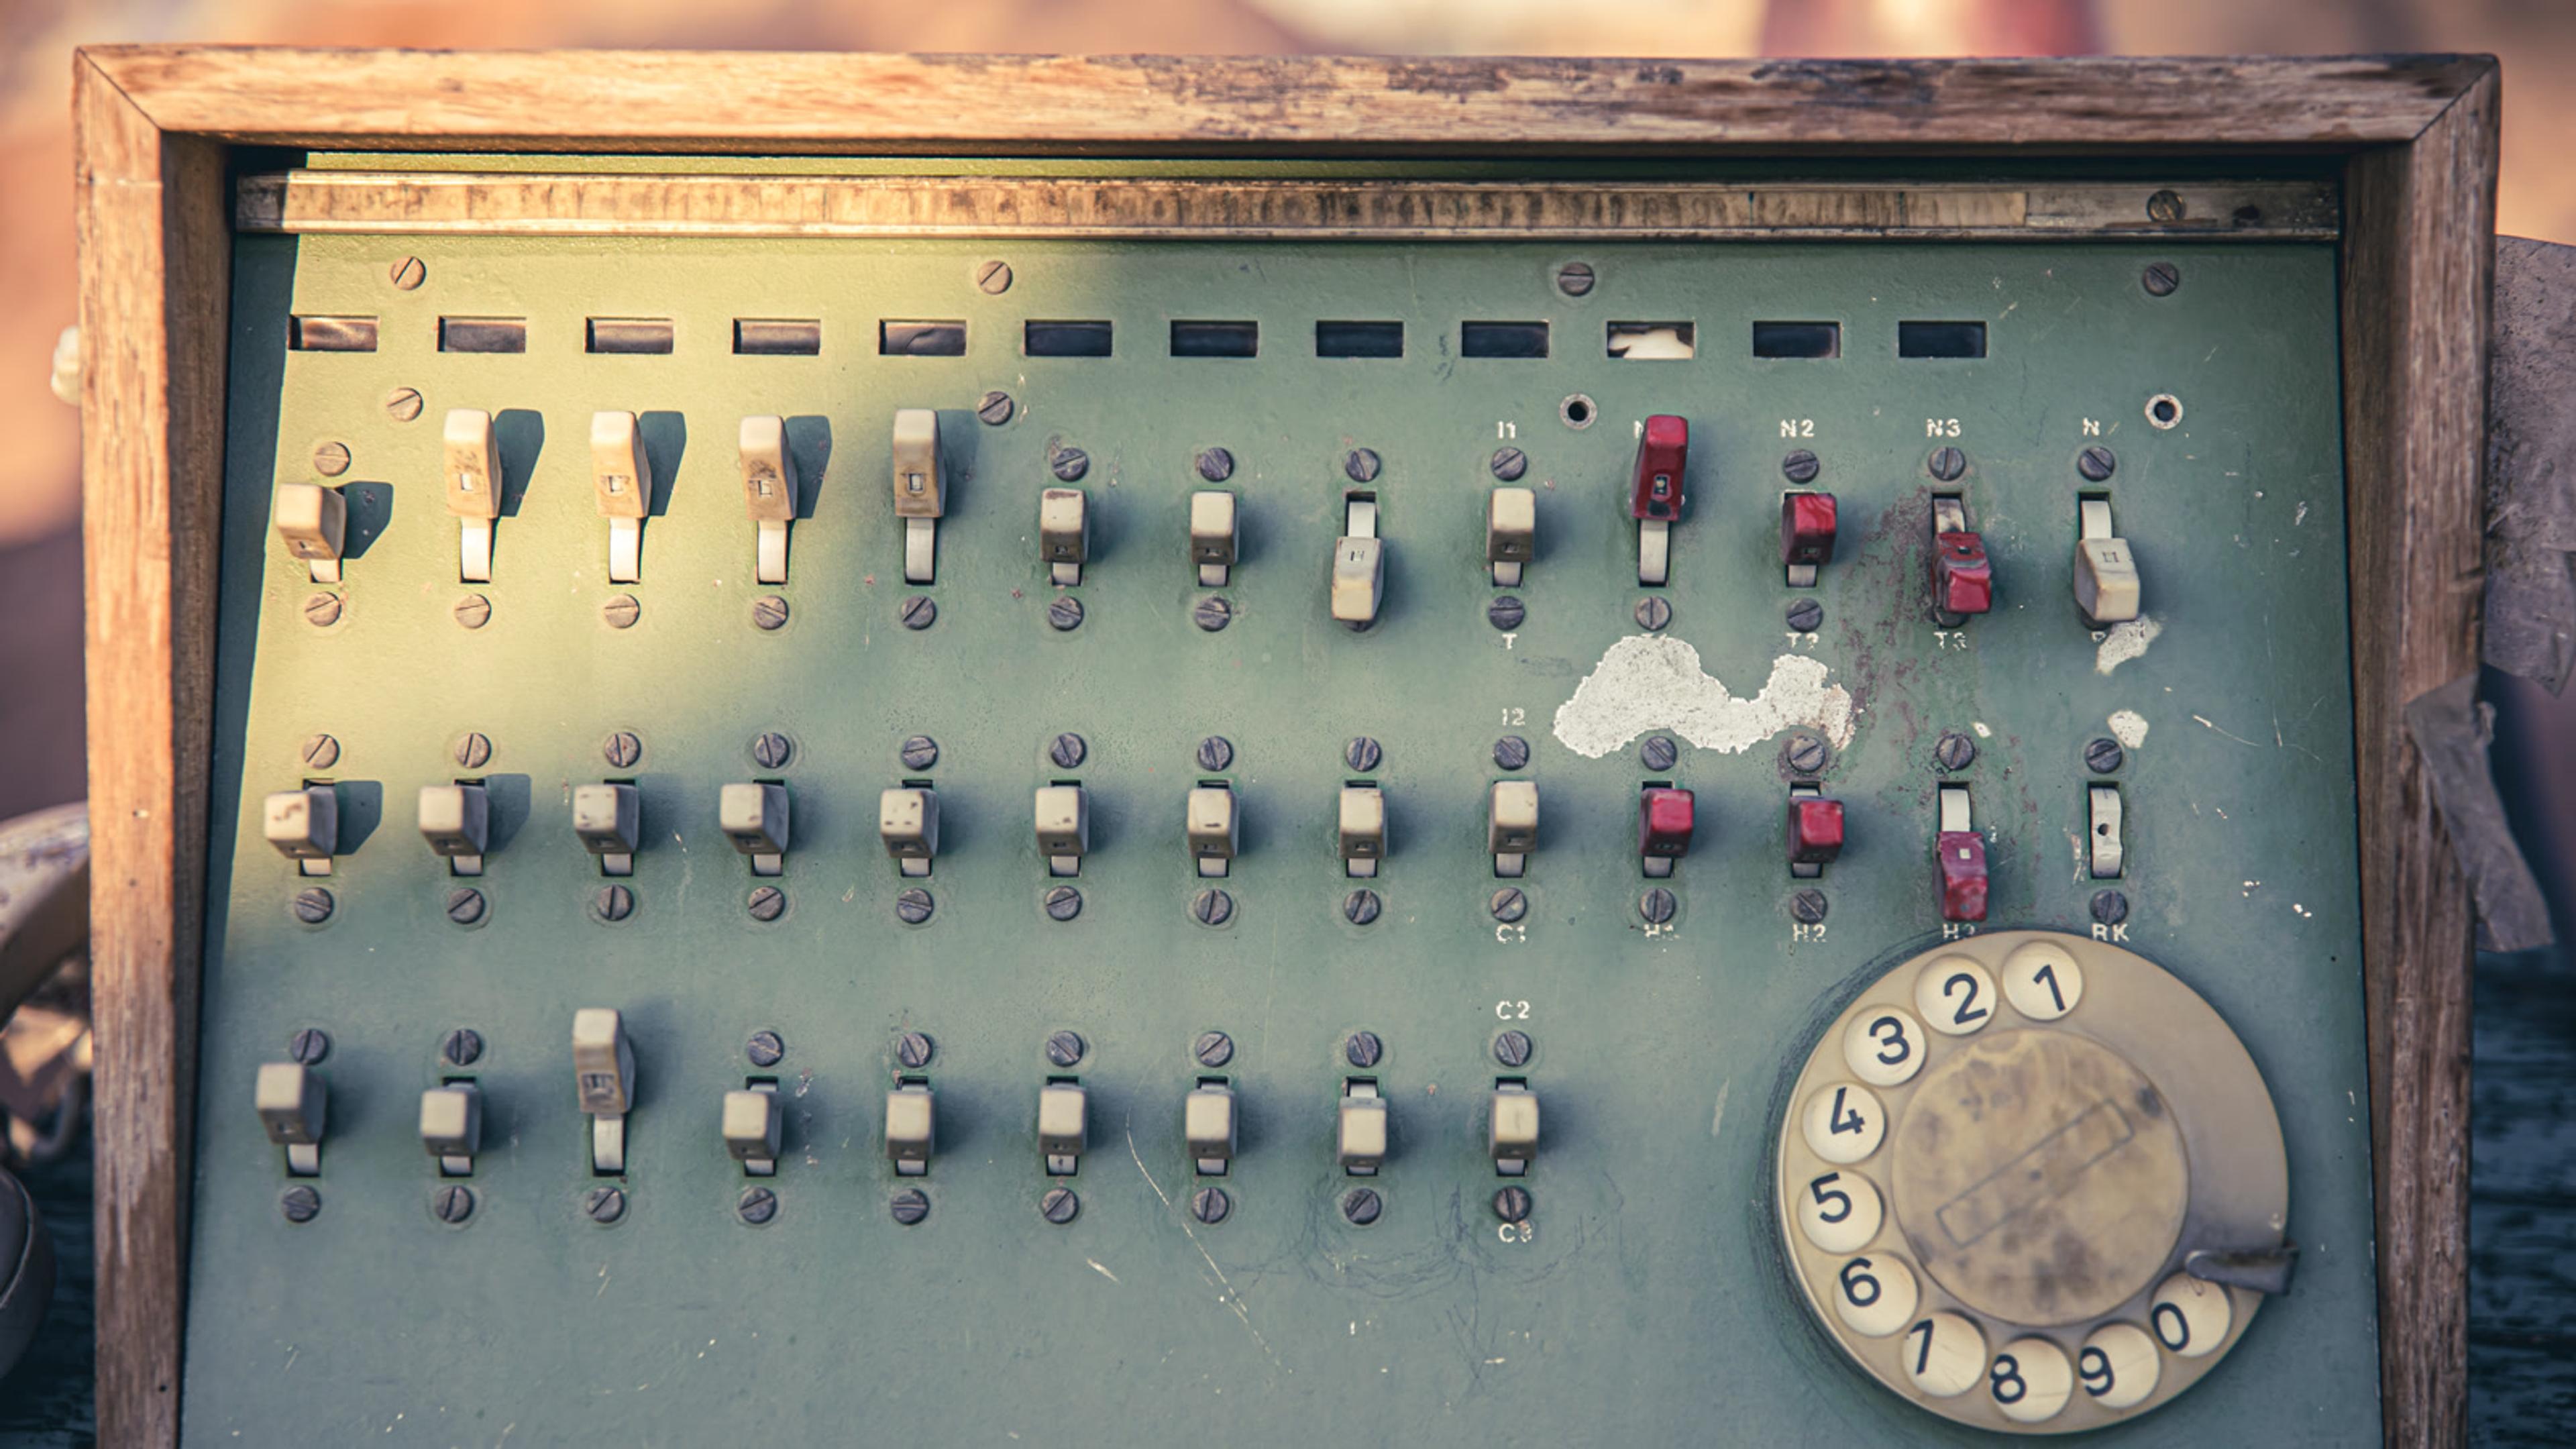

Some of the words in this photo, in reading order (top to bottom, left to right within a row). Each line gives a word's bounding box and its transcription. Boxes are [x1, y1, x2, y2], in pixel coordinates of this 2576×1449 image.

[1780, 419, 1815, 437] N2
[1927, 418, 1961, 438] N3
[1502, 633, 1518, 650] T
[1495, 924, 1525, 944] C1
[1792, 924, 1827, 943] H2
[2092, 922, 2129, 942] RK
[1495, 1000, 1530, 1020] C2
[1944, 973, 1988, 1025] 2
[2033, 965, 2066, 1012] 1
[1868, 1016, 1911, 1065] 3
[1829, 1086, 1866, 1136] 4
[1810, 1172, 1852, 1223] 5
[1839, 1256, 1881, 1307] 6
[2151, 1302, 2190, 1352] 0
[1990, 1353, 2027, 1404] 8
[2080, 1346, 2115, 1397] 9
